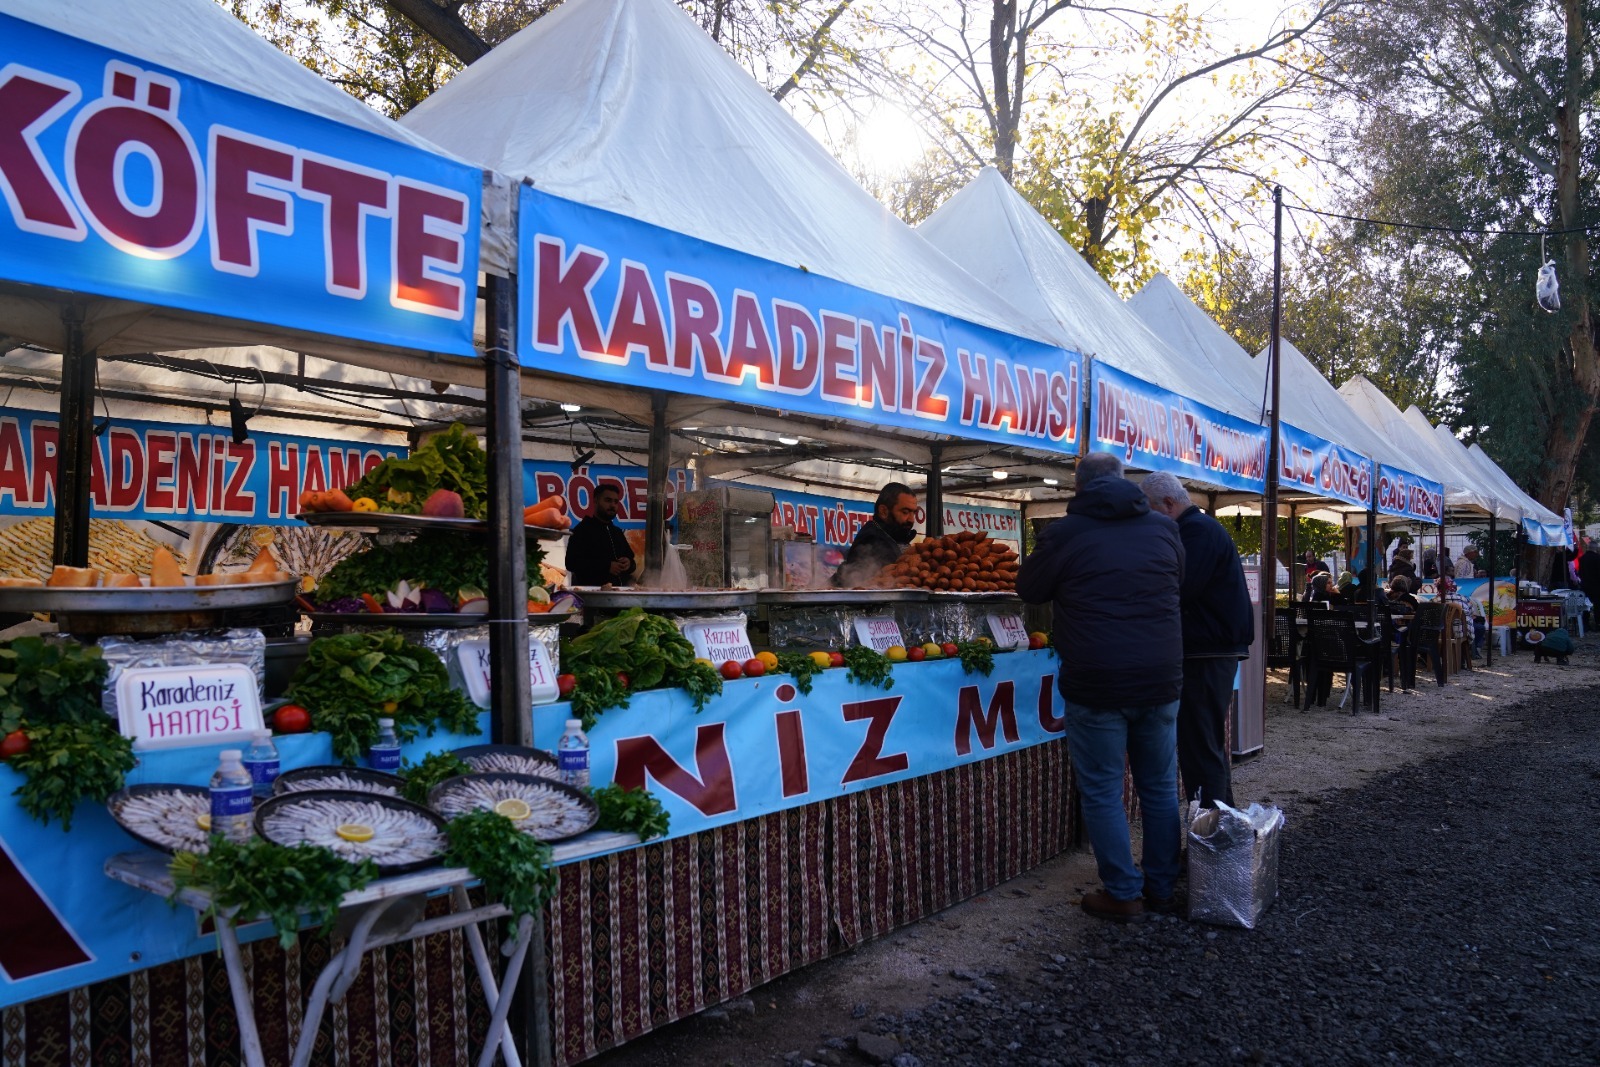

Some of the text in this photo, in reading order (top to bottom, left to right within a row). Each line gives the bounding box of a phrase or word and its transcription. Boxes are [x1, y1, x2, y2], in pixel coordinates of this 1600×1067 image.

[0, 59, 470, 320] KÖFTE
[533, 234, 1078, 444] KARADENİZ HAMSİ
[1097, 378, 1171, 464] MEŞHUR
[1170, 397, 1202, 466] RİZE
[268, 440, 397, 520] HAM
[1280, 438, 1316, 488] LAZ
[771, 500, 819, 543] ABAT
[823, 502, 874, 546] KÖFT
[704, 628, 740, 645] KAZAN
[707, 645, 752, 662] KAVURMA
[141, 676, 235, 711] Karadeniz
[148, 698, 243, 738] HAMSİ
[955, 673, 1067, 757] MU
